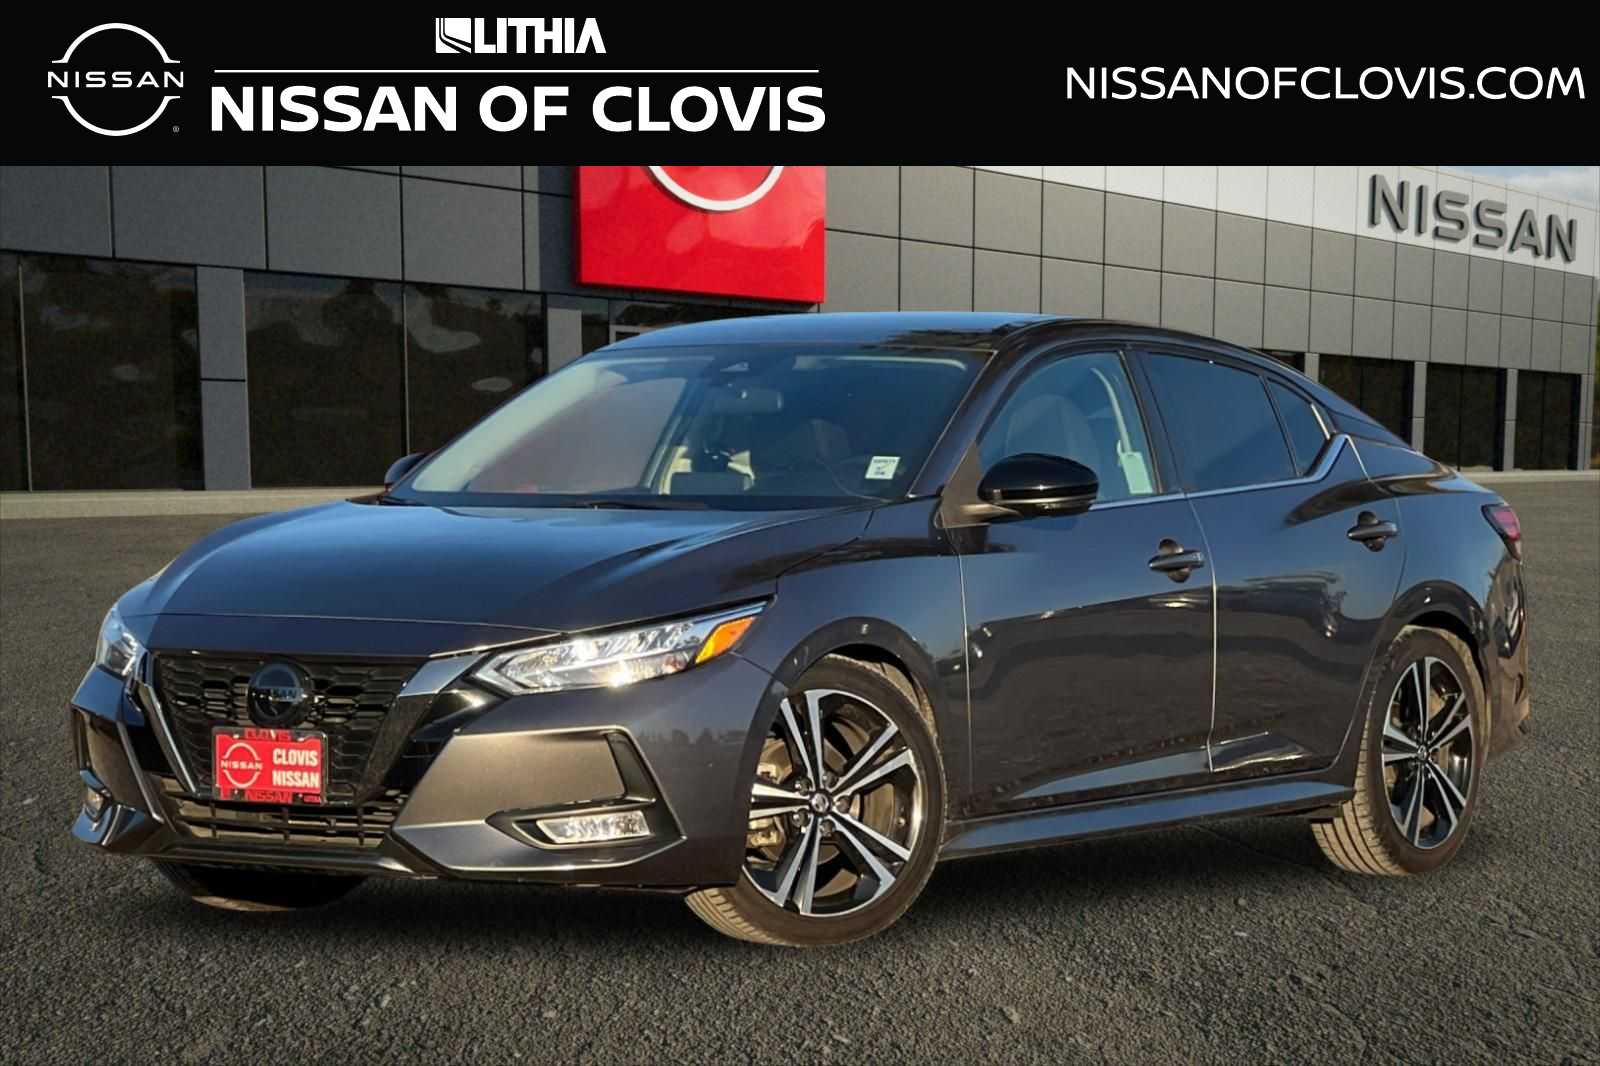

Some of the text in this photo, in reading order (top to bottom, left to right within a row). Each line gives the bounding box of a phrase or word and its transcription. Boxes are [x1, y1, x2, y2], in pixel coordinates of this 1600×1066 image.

[1368, 173, 1578, 263] NISSAN
[220, 760, 263, 770] NISSAN
[273, 748, 318, 767] CLOVIS
[271, 770, 320, 788] NISSAN
